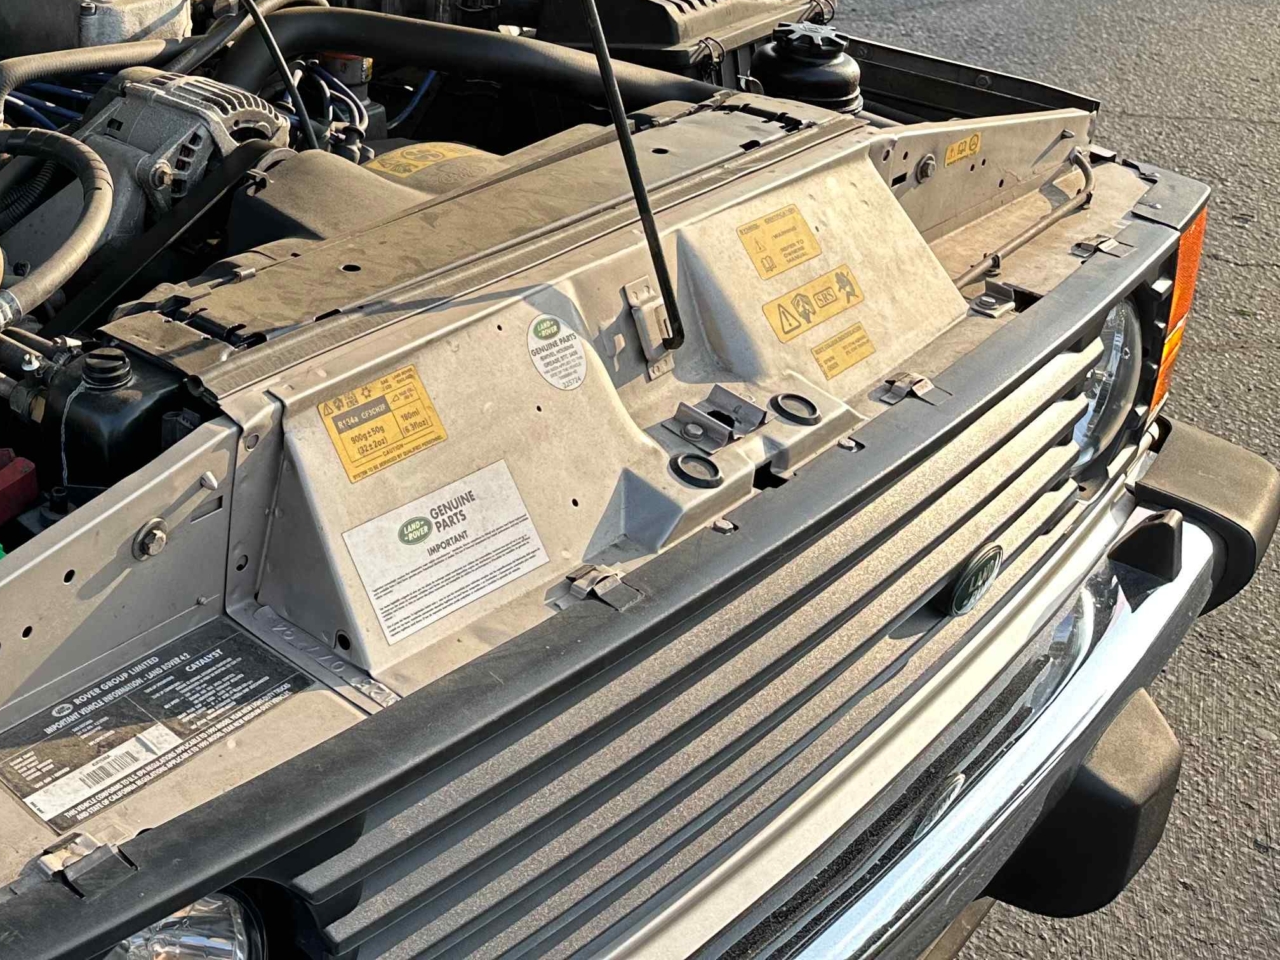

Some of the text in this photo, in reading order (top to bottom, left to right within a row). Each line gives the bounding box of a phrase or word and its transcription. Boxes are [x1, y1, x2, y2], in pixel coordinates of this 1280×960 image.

[795, 238, 805, 246] TO
[785, 249, 809, 264] MANUAL
[815, 288, 835, 306] SRS
[536, 320, 552, 331] LAND
[539, 324, 558, 337] ROVER
[529, 331, 577, 357] GENUINE PARTS
[336, 413, 359, 430] R134a
[349, 407, 421, 446] 900g±50g 180ml
[356, 435, 389, 456] (32±2oz)
[381, 442, 405, 457] CAUTION
[401, 489, 476, 535] LAND GENUINE
[406, 508, 468, 541] ROVER PARTS
[425, 529, 469, 557] IMPORTANT
[183, 647, 225, 673] CATALYST
[71, 686, 102, 705] ROVER
[97, 670, 131, 691] GROUP
[126, 654, 161, 675] LIMITED
[42, 710, 82, 735] IMPORTANT
[77, 698, 105, 716] VEHICLE
[100, 676, 144, 703] INFORMATION
[144, 666, 164, 679] LAND
[159, 656, 183, 671] ROVER
[177, 651, 191, 661] 4.2
[73, 796, 98, 813] VEHICLE
[143, 749, 177, 771] REGULATIONS
[172, 734, 203, 754] APPLICABLE
[213, 716, 234, 730] MODEL
[271, 681, 292, 695] TRUCKS
[106, 781, 138, 803] CALIFORNIA
[133, 763, 169, 787] REGULATIONS
[163, 748, 194, 769] APPLICABLE
[205, 729, 226, 743] MODEL
